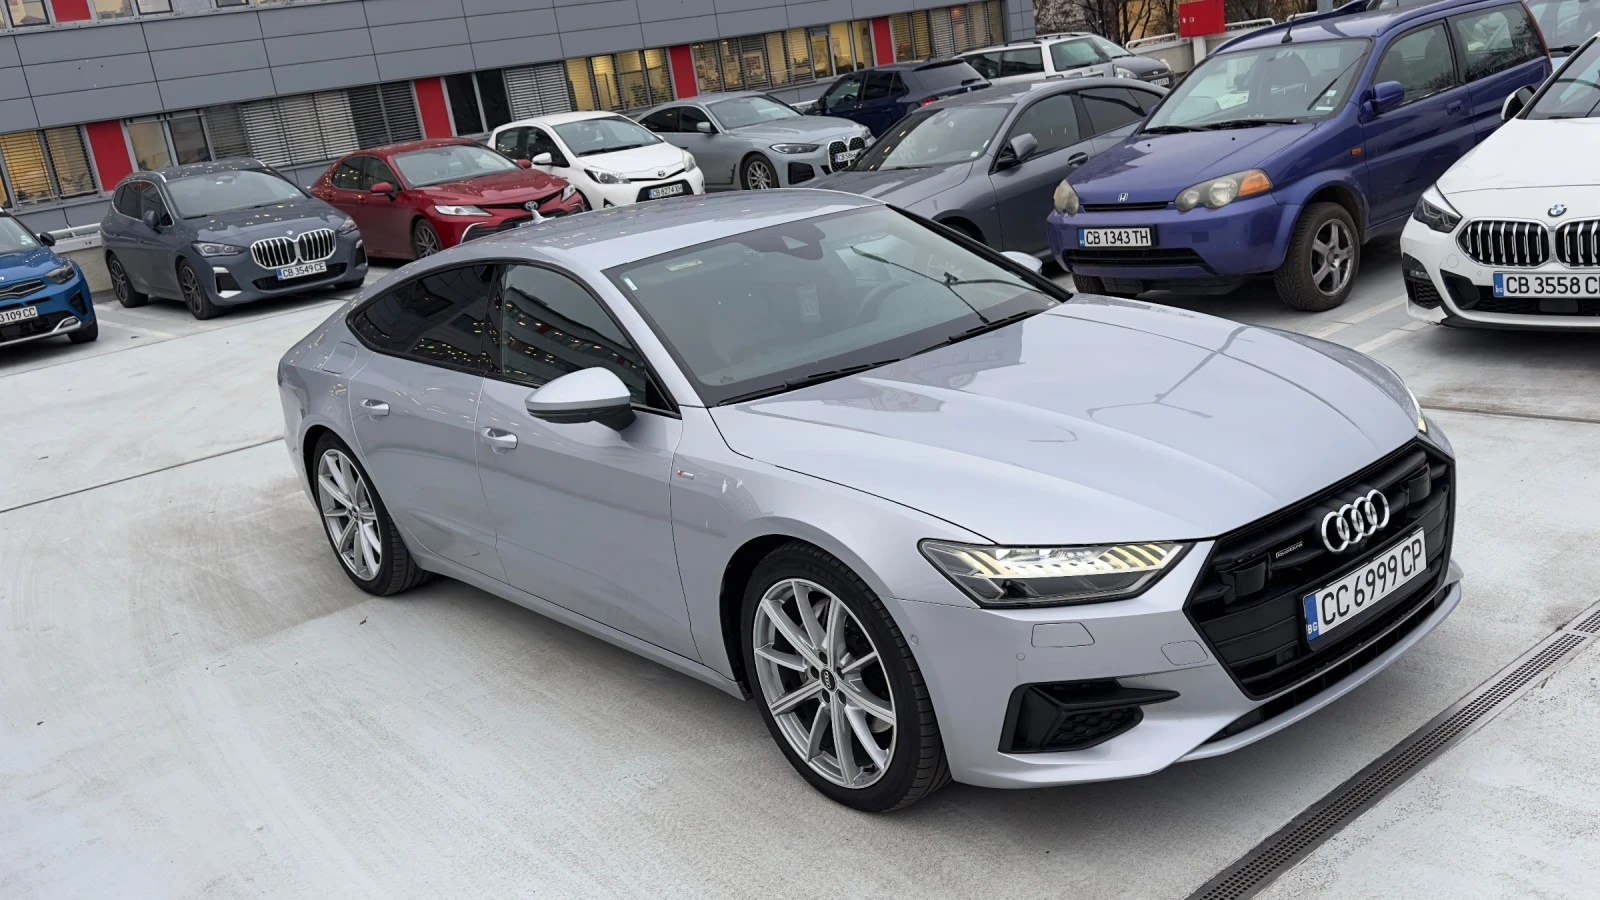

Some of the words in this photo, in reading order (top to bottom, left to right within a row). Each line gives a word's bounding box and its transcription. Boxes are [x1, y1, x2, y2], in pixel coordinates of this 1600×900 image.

[653, 189, 660, 197] CB
[1086, 231, 1100, 244] CB
[1104, 231, 1131, 244] 1343
[1132, 230, 1149, 244] TH
[283, 269, 294, 278] CB
[295, 264, 314, 276] 3549
[314, 262, 325, 271] CE
[1506, 276, 1530, 294] CB
[1534, 276, 1581, 295] 3558
[1585, 276, 1600, 294] C
[0, 311, 22, 323] 3109
[22, 307, 37, 318] CC
[1321, 584, 1350, 626] CC
[1354, 554, 1398, 608] 6999
[1401, 538, 1422, 577] CP
[1307, 621, 1318, 635] BG
